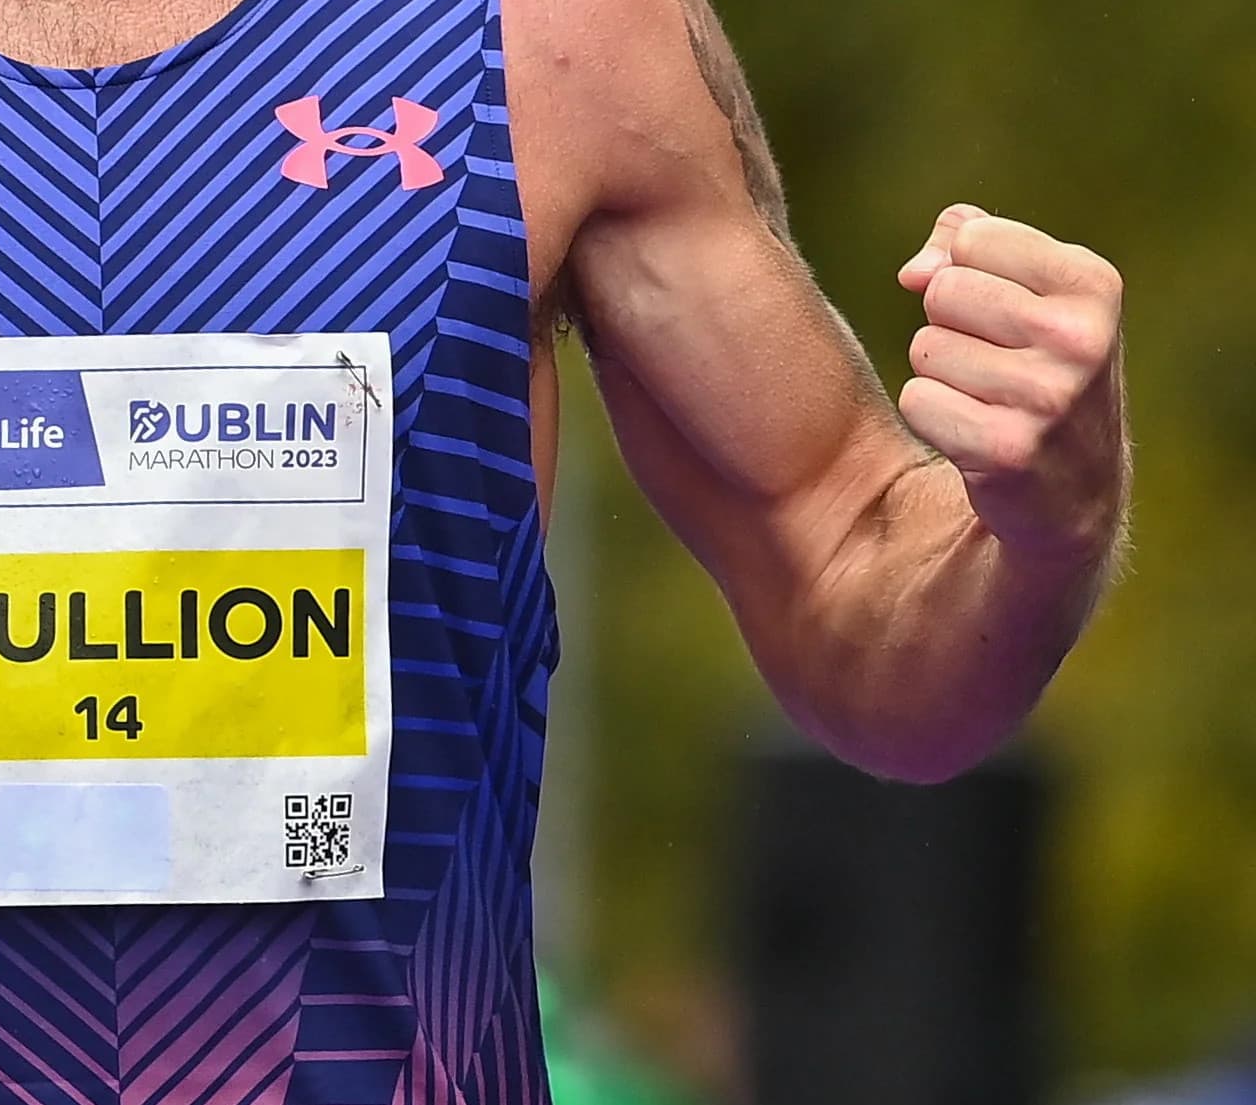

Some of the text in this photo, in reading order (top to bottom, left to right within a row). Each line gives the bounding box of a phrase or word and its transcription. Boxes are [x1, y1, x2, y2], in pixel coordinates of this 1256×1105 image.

[1, 417, 64, 450] Life
[129, 400, 336, 444] DUBLIN
[129, 449, 338, 470] MARATHON 2023
[74, 696, 143, 741] 14
